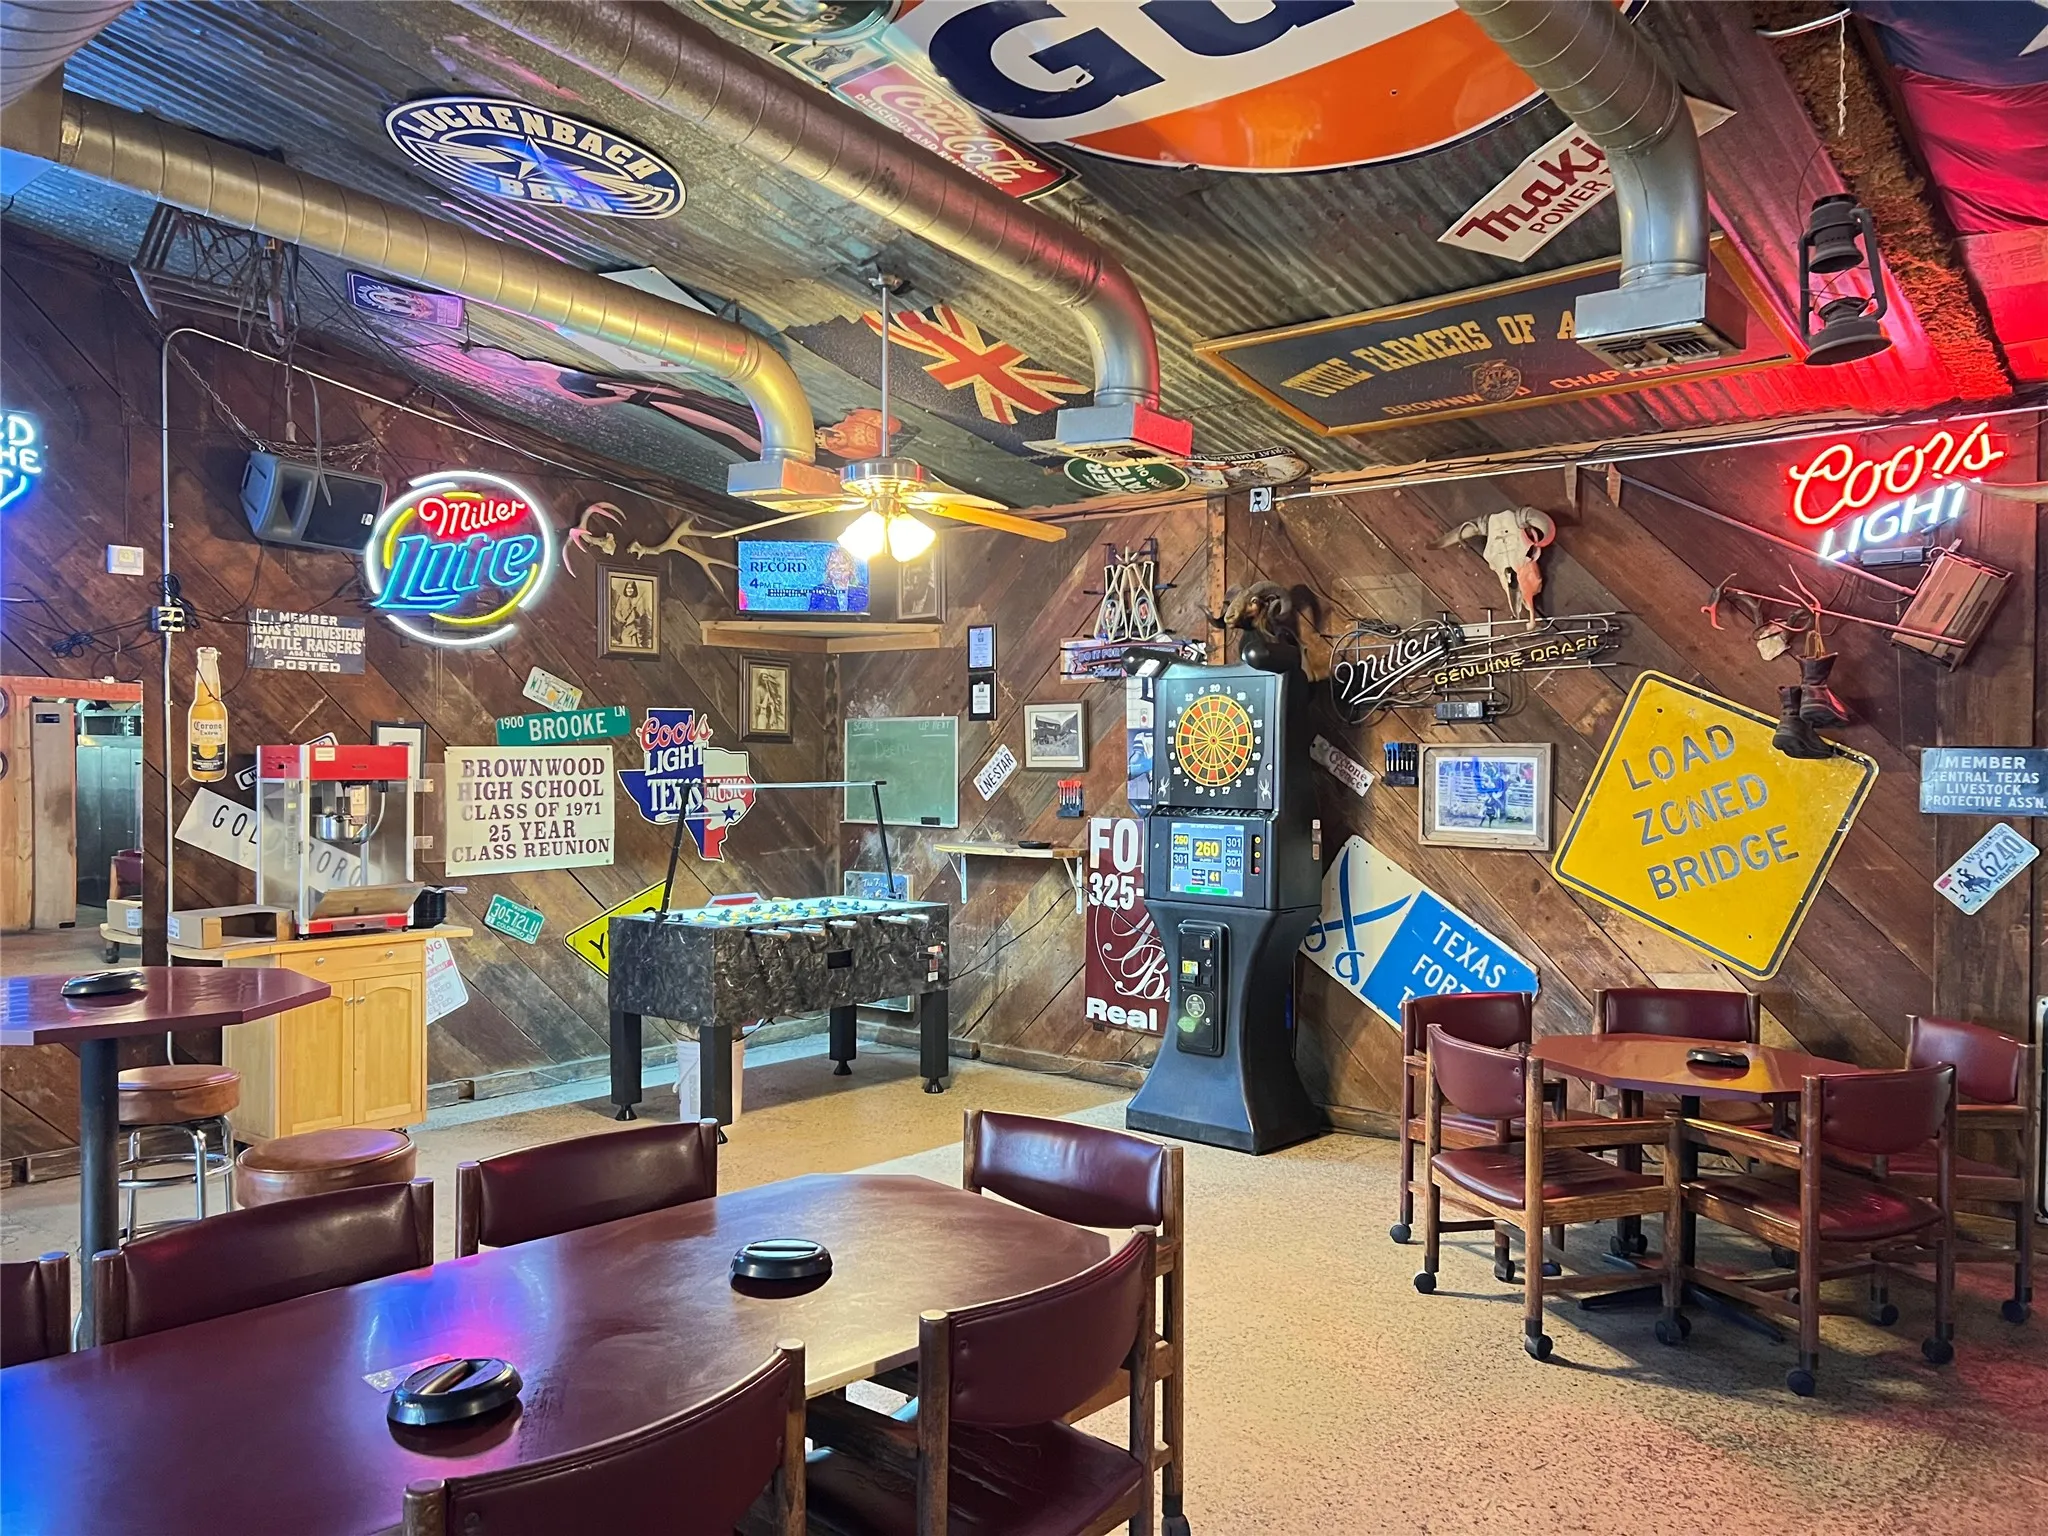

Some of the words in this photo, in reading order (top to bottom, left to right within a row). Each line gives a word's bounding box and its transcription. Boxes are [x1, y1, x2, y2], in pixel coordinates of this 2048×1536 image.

[854, 93, 915, 135] DELICIOUS
[912, 131, 939, 152] AND
[397, 104, 662, 180] LUCKENBACH
[495, 175, 614, 212] BEER
[1528, 179, 1607, 234] POWER
[1350, 319, 1494, 372] FARMERS
[1497, 313, 1537, 345] OF
[1789, 421, 2004, 525] Coors
[418, 497, 526, 537] Miller
[1818, 481, 1966, 562] LIGHT
[370, 533, 538, 609] Lite
[750, 561, 807, 573] RECORD
[279, 611, 338, 627] MEMBER
[252, 623, 281, 636] TEXAS
[283, 623, 292, 637] &
[293, 623, 365, 642] SOUTHWESTERN
[253, 634, 302, 651] CATTLE
[306, 638, 362, 655] RAISERS
[273, 659, 341, 673] POSTED
[1334, 632, 1441, 700] Miller
[1434, 654, 1524, 686] GENUINE
[1530, 634, 1600, 663] DRAFT
[1209, 684, 1221, 693] 20
[1247, 704, 1254, 714] 4
[193, 721, 223, 732] Corona
[500, 715, 525, 730] 1900
[528, 712, 608, 742] BROOKE
[614, 705, 626, 717] LN
[636, 713, 713, 751] Coors
[460, 757, 606, 778] BROWNWOOD
[644, 742, 708, 776] LIGHT
[1621, 723, 1737, 791] LOAD
[1944, 756, 2027, 770] MEMBER
[705, 777, 747, 801] MUSIC
[1333, 764, 1363, 789] Fence
[1946, 783, 2022, 796] LIVESTOCK
[1995, 772, 2040, 784] TEXAS
[456, 781, 514, 802] HIGH
[520, 778, 605, 800] SCHOOL
[1925, 795, 2002, 808] PROTECTIVE
[461, 803, 528, 822] CLASS
[534, 802, 560, 818] OF
[565, 801, 602, 817] 1971
[1632, 773, 1769, 847] ZONED
[488, 823, 512, 843] 25
[519, 819, 577, 841] YEAR
[1173, 834, 1189, 845] 260
[1226, 837, 1242, 848] 301
[451, 843, 517, 863] CLASS
[523, 837, 611, 858] REUNION
[1089, 817, 1144, 874] FO
[1194, 840, 1220, 857] 260
[1963, 827, 2012, 865] Wyoming
[1978, 833, 2025, 879] 6240
[1173, 854, 1188, 864] 301
[1226, 857, 1242, 867] 301
[1646, 823, 1800, 901] BRIDGE
[1208, 871, 1220, 882] 41
[1994, 860, 2020, 886] TRUCK
[1089, 871, 1145, 911] 325-
[490, 903, 540, 936] 30572LU
[1432, 920, 1507, 989] TEXAS
[1086, 996, 1158, 1031] Real
